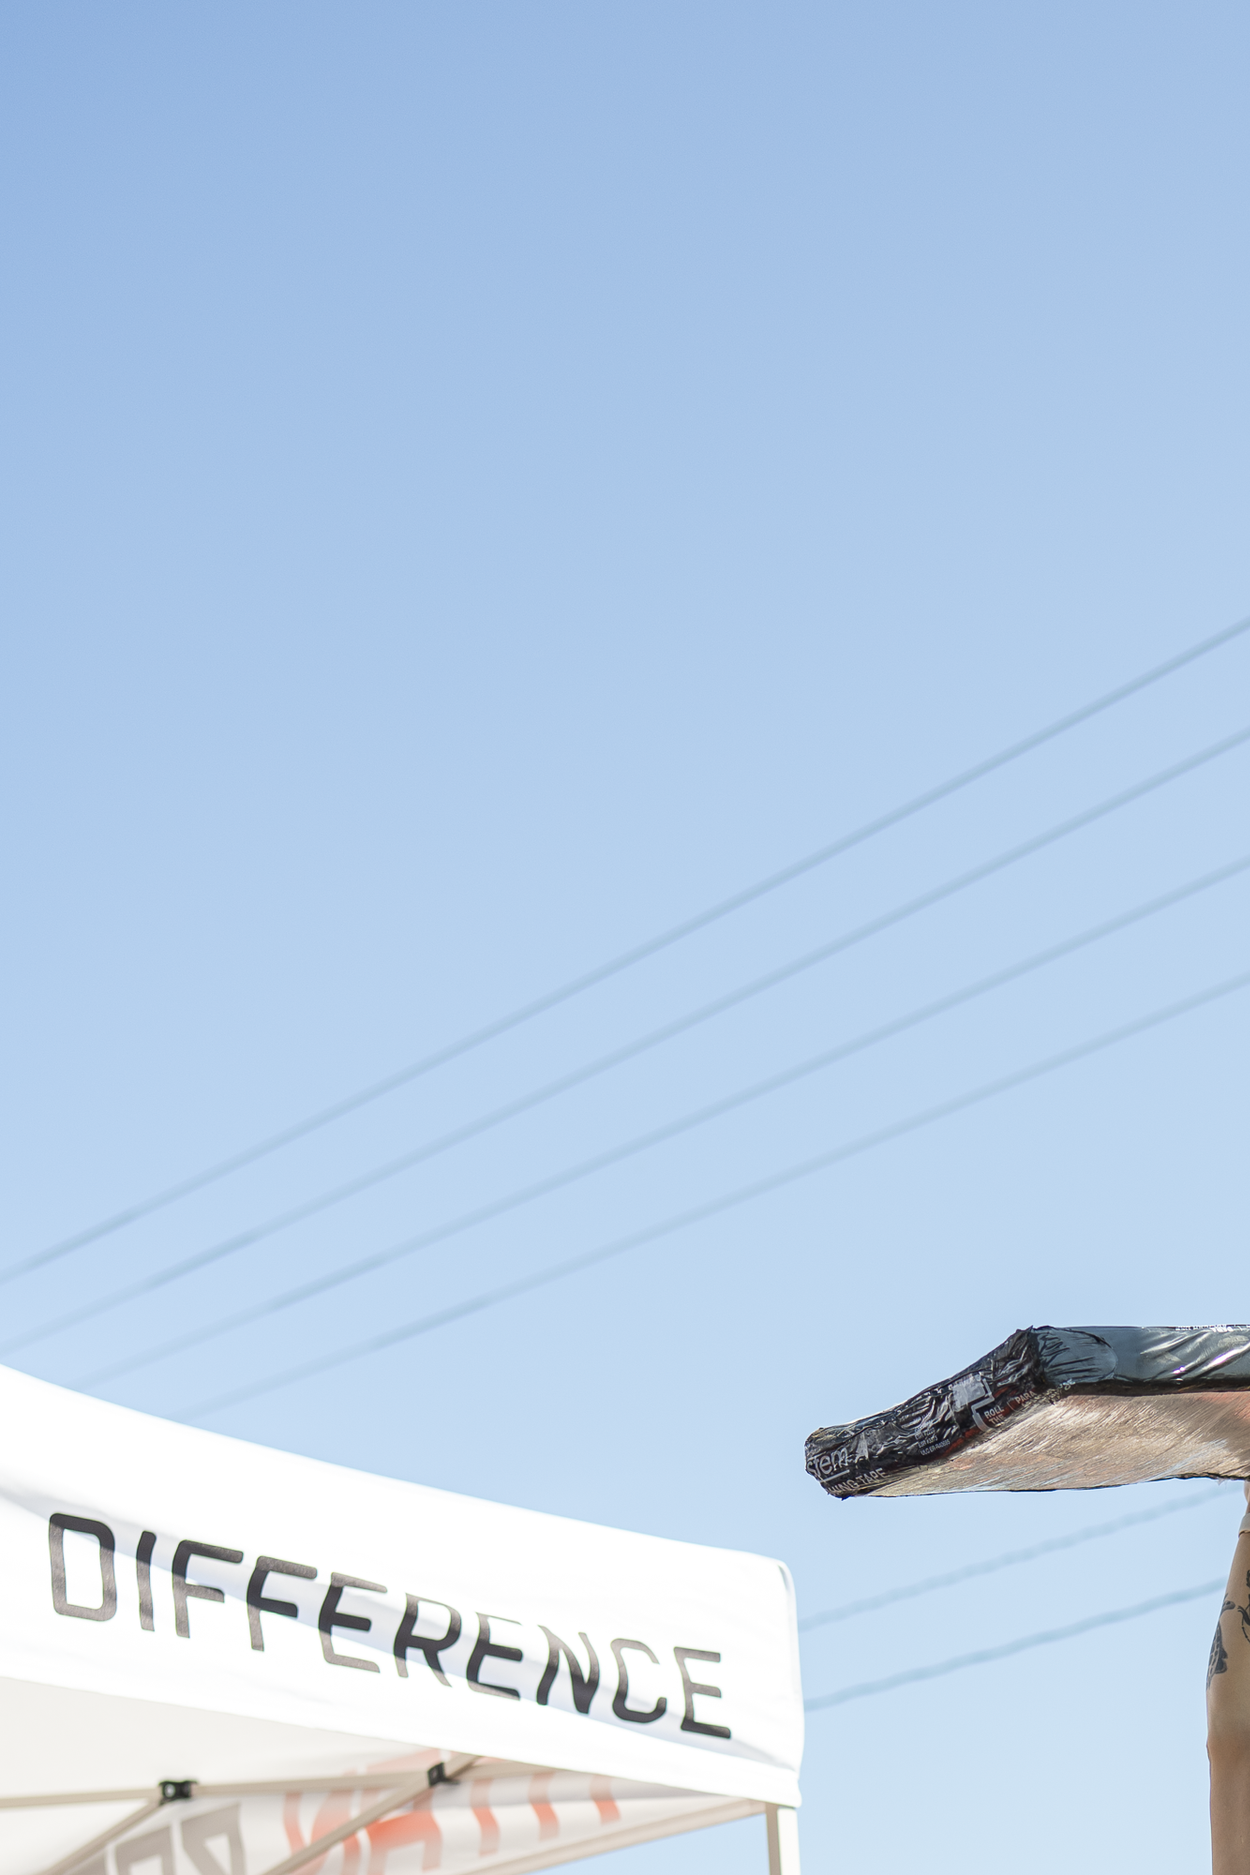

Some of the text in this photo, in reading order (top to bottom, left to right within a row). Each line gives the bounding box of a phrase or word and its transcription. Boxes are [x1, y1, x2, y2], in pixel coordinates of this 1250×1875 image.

[984, 1405, 1005, 1419] ROLL
[856, 1467, 889, 1485] TAPE
[48, 1512, 732, 1740] DIFFERENCE
